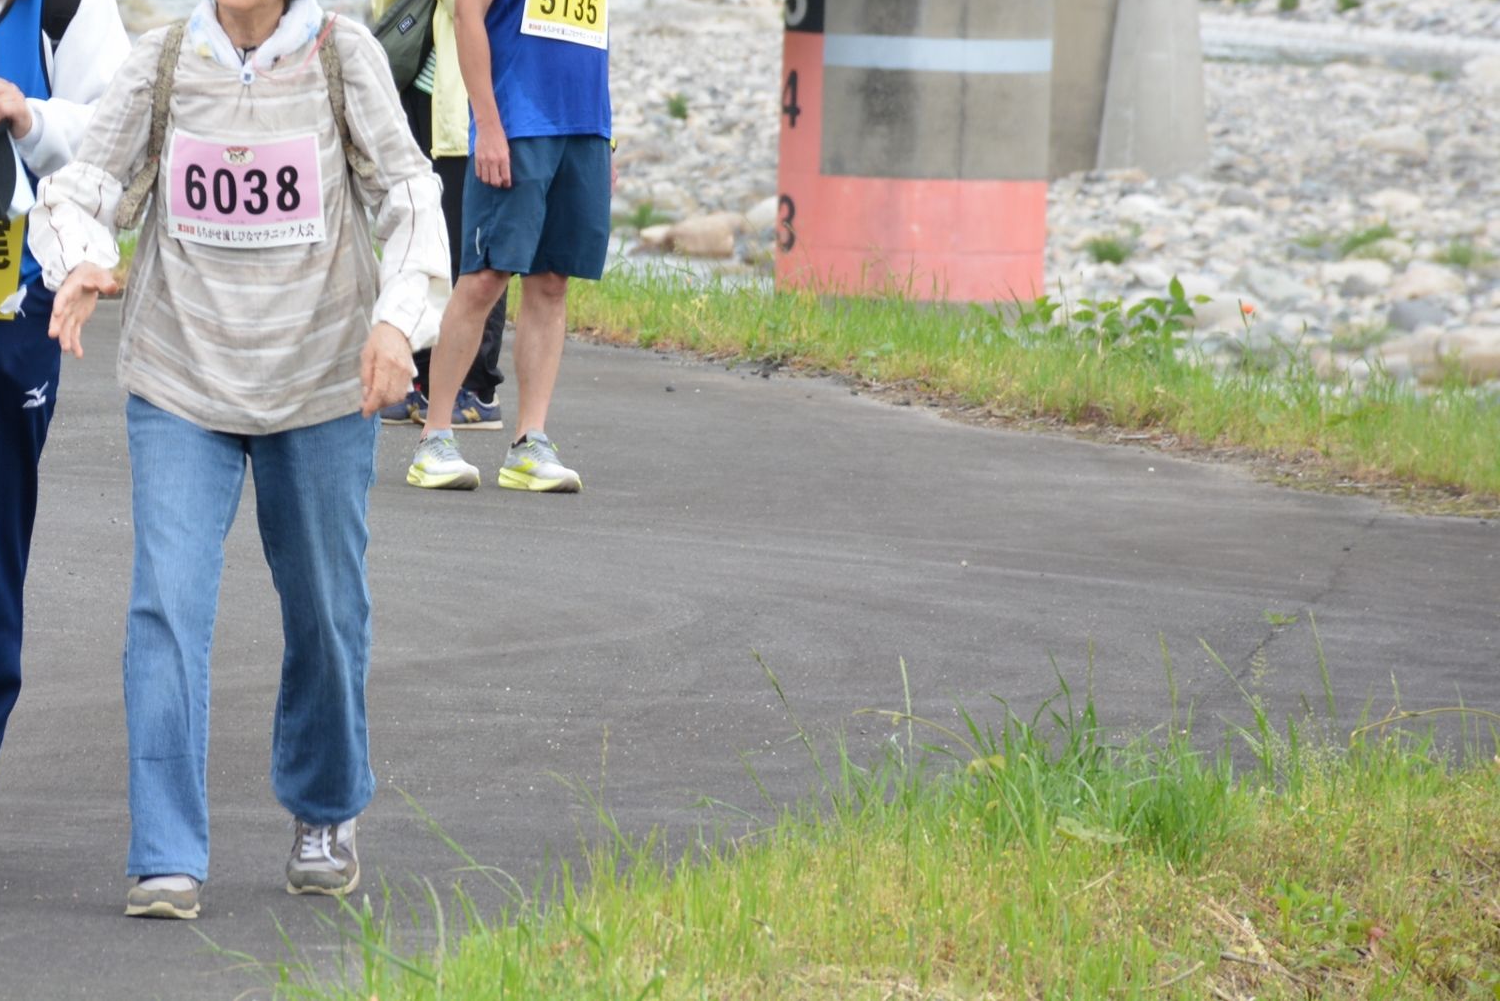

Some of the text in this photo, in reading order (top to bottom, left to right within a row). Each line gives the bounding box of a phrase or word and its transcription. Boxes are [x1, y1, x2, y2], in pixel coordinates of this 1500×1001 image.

[782, 69, 800, 128] 4
[185, 163, 301, 215] 6038
[777, 194, 796, 254] 3
